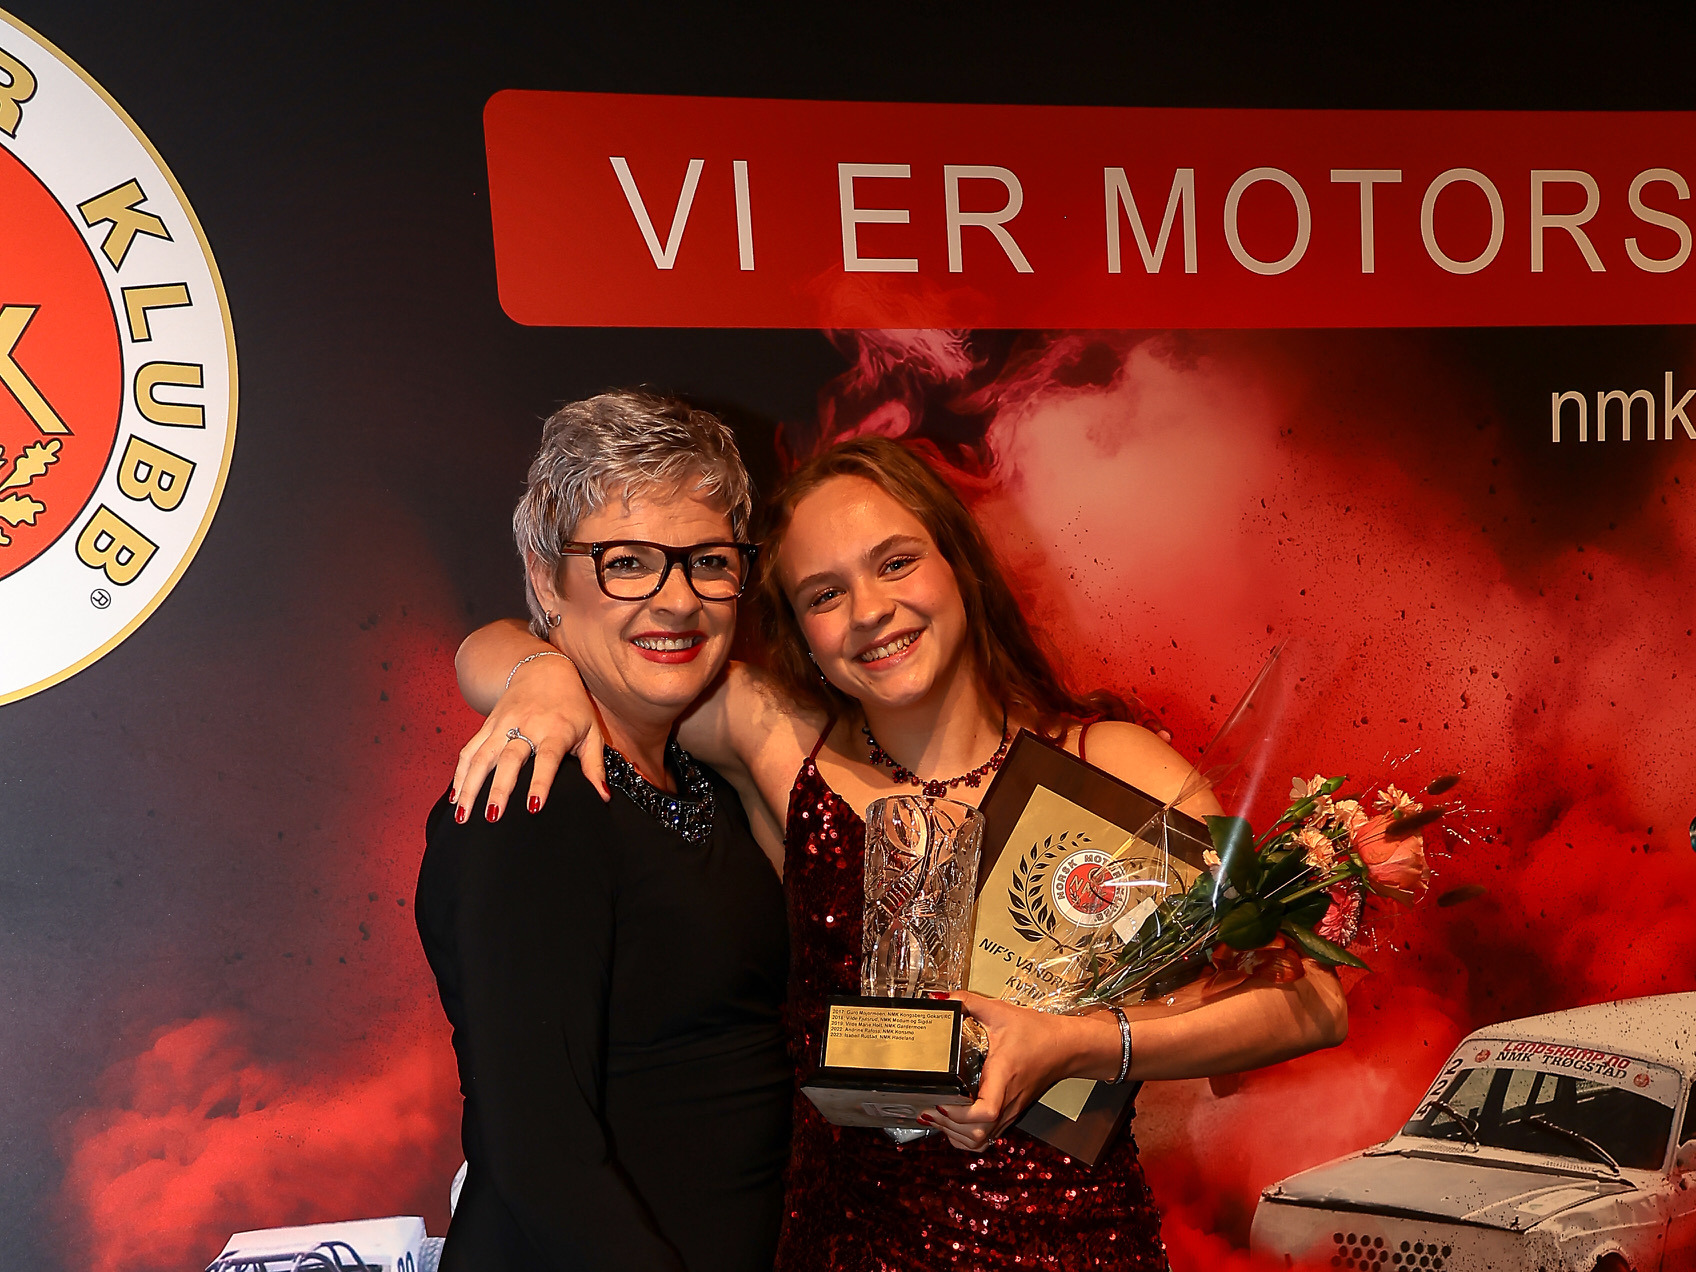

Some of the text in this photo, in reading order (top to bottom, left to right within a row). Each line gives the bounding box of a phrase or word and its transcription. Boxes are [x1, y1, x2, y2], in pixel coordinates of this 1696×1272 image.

[609, 156, 1693, 275] VI ER MOTORS
[77, 177, 206, 586] KLUBB
[1551, 371, 1696, 443] nmk
[1056, 859, 1078, 900] NORSK
[1085, 854, 1124, 878] MOTR
[979, 937, 1015, 962] NIF'S
[1496, 1051, 1628, 1079] NMK TRØGSTAD
